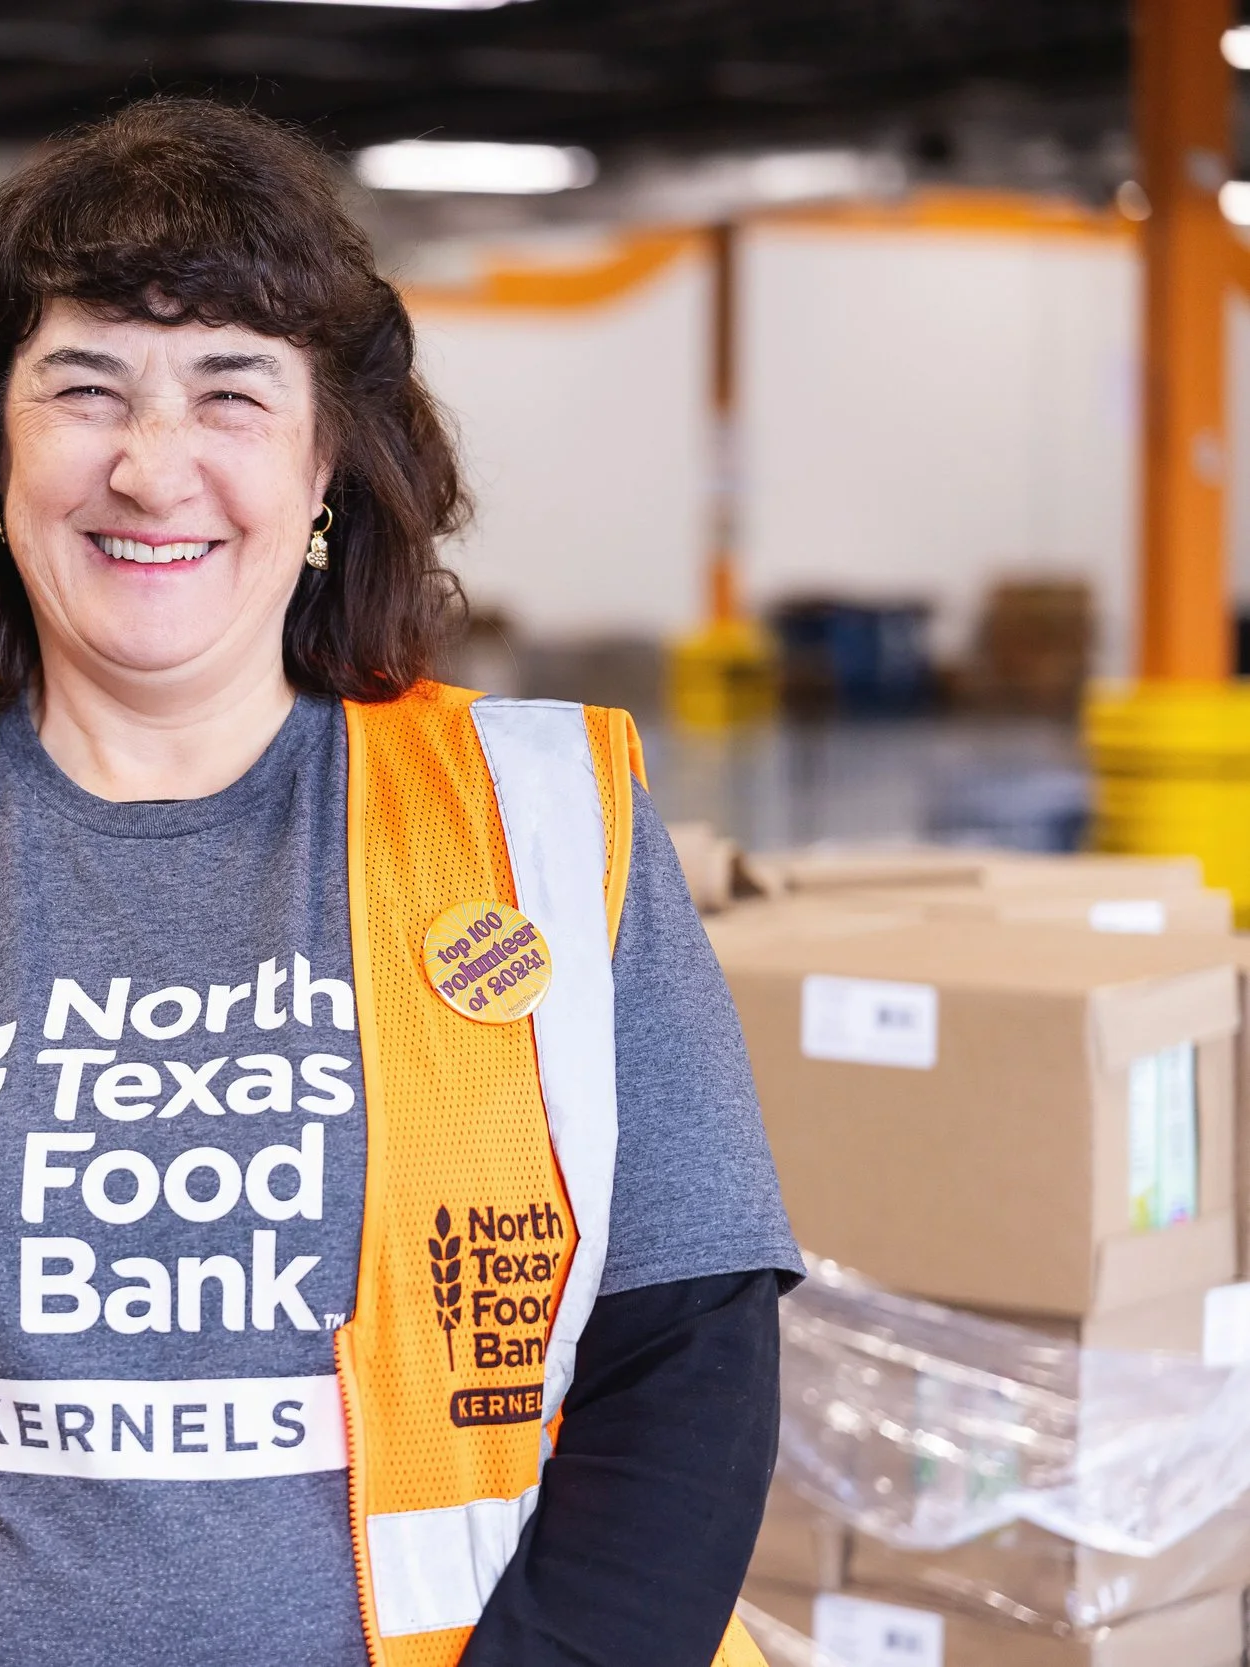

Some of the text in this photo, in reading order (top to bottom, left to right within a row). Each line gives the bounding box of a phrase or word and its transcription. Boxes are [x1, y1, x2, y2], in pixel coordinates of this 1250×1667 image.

[437, 911, 503, 964] top 100
[437, 921, 537, 998] volunteer
[43, 952, 355, 1040] North
[468, 949, 545, 1011] of 2024!
[37, 1048, 355, 1121] Texas
[21, 1122, 324, 1224] Food
[468, 1202, 564, 1243] North
[19, 1230, 321, 1334] Bank
[473, 1327, 547, 1369] Ban
